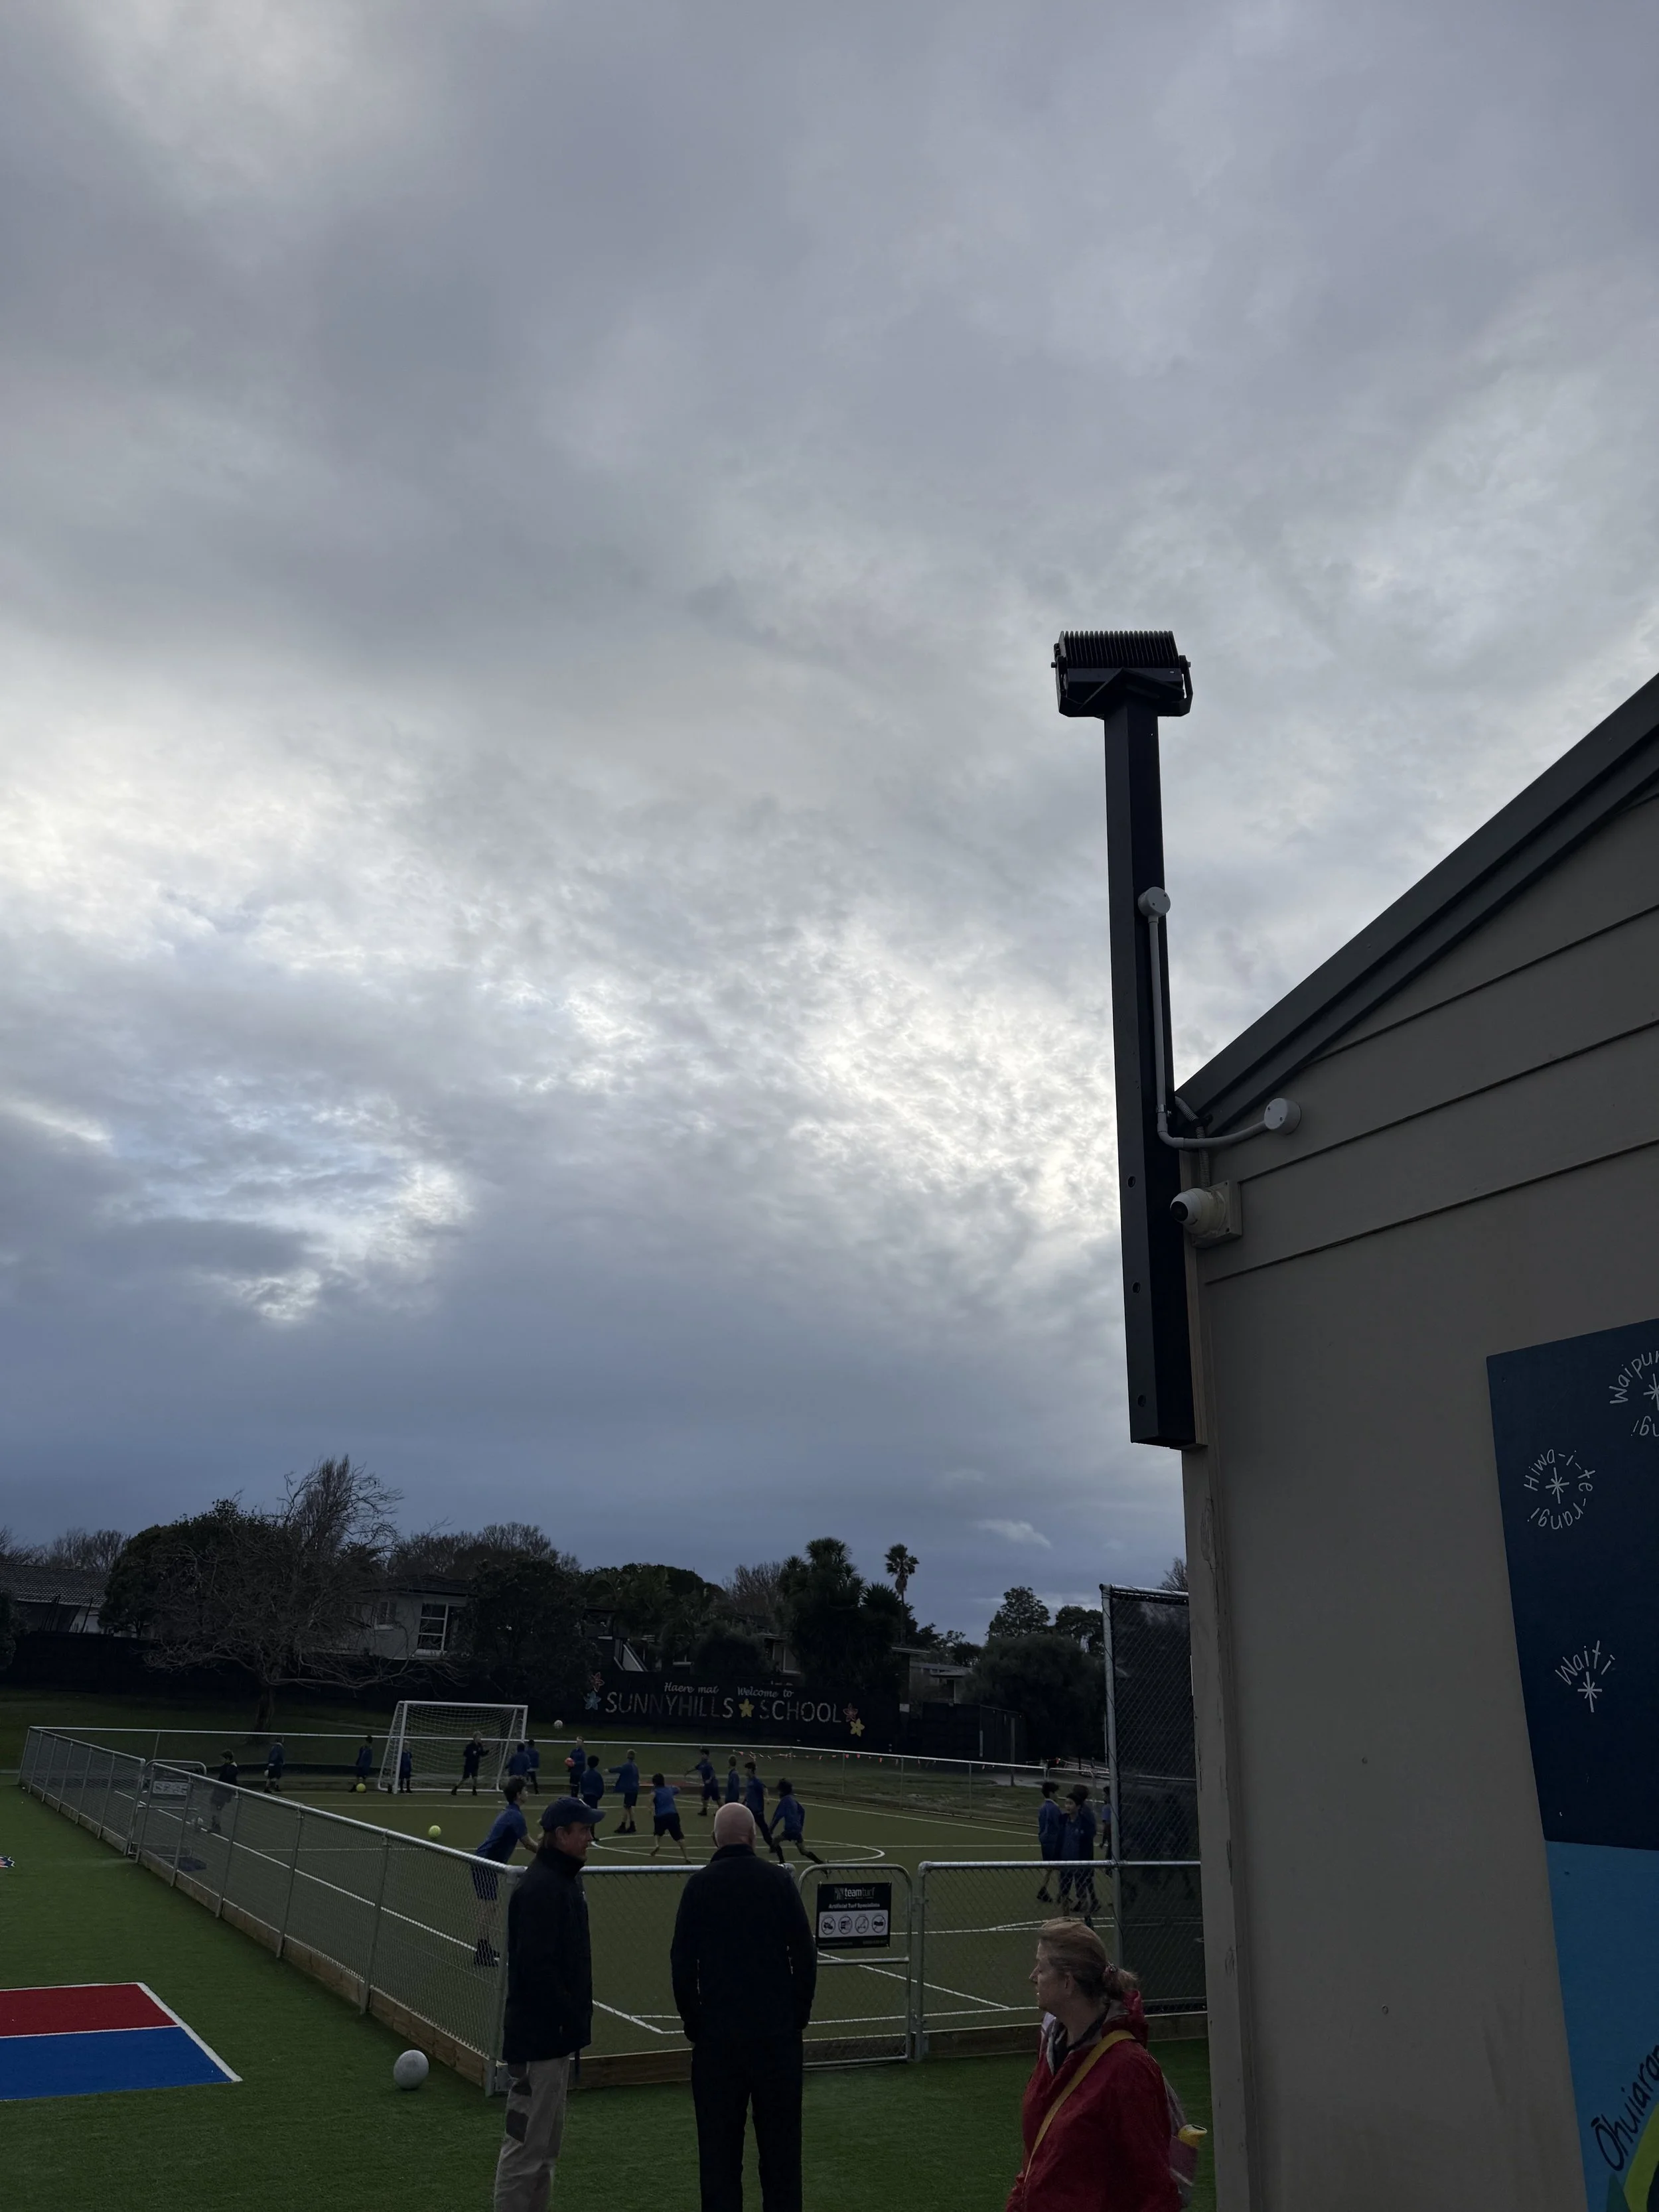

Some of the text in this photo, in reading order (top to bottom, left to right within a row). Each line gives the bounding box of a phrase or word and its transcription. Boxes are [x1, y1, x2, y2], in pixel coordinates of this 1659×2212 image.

[664, 1682, 695, 1693] Haere
[737, 1686, 794, 1698] Welcome to
[605, 1691, 841, 1723] SUNNYHILLS SCHOOL
